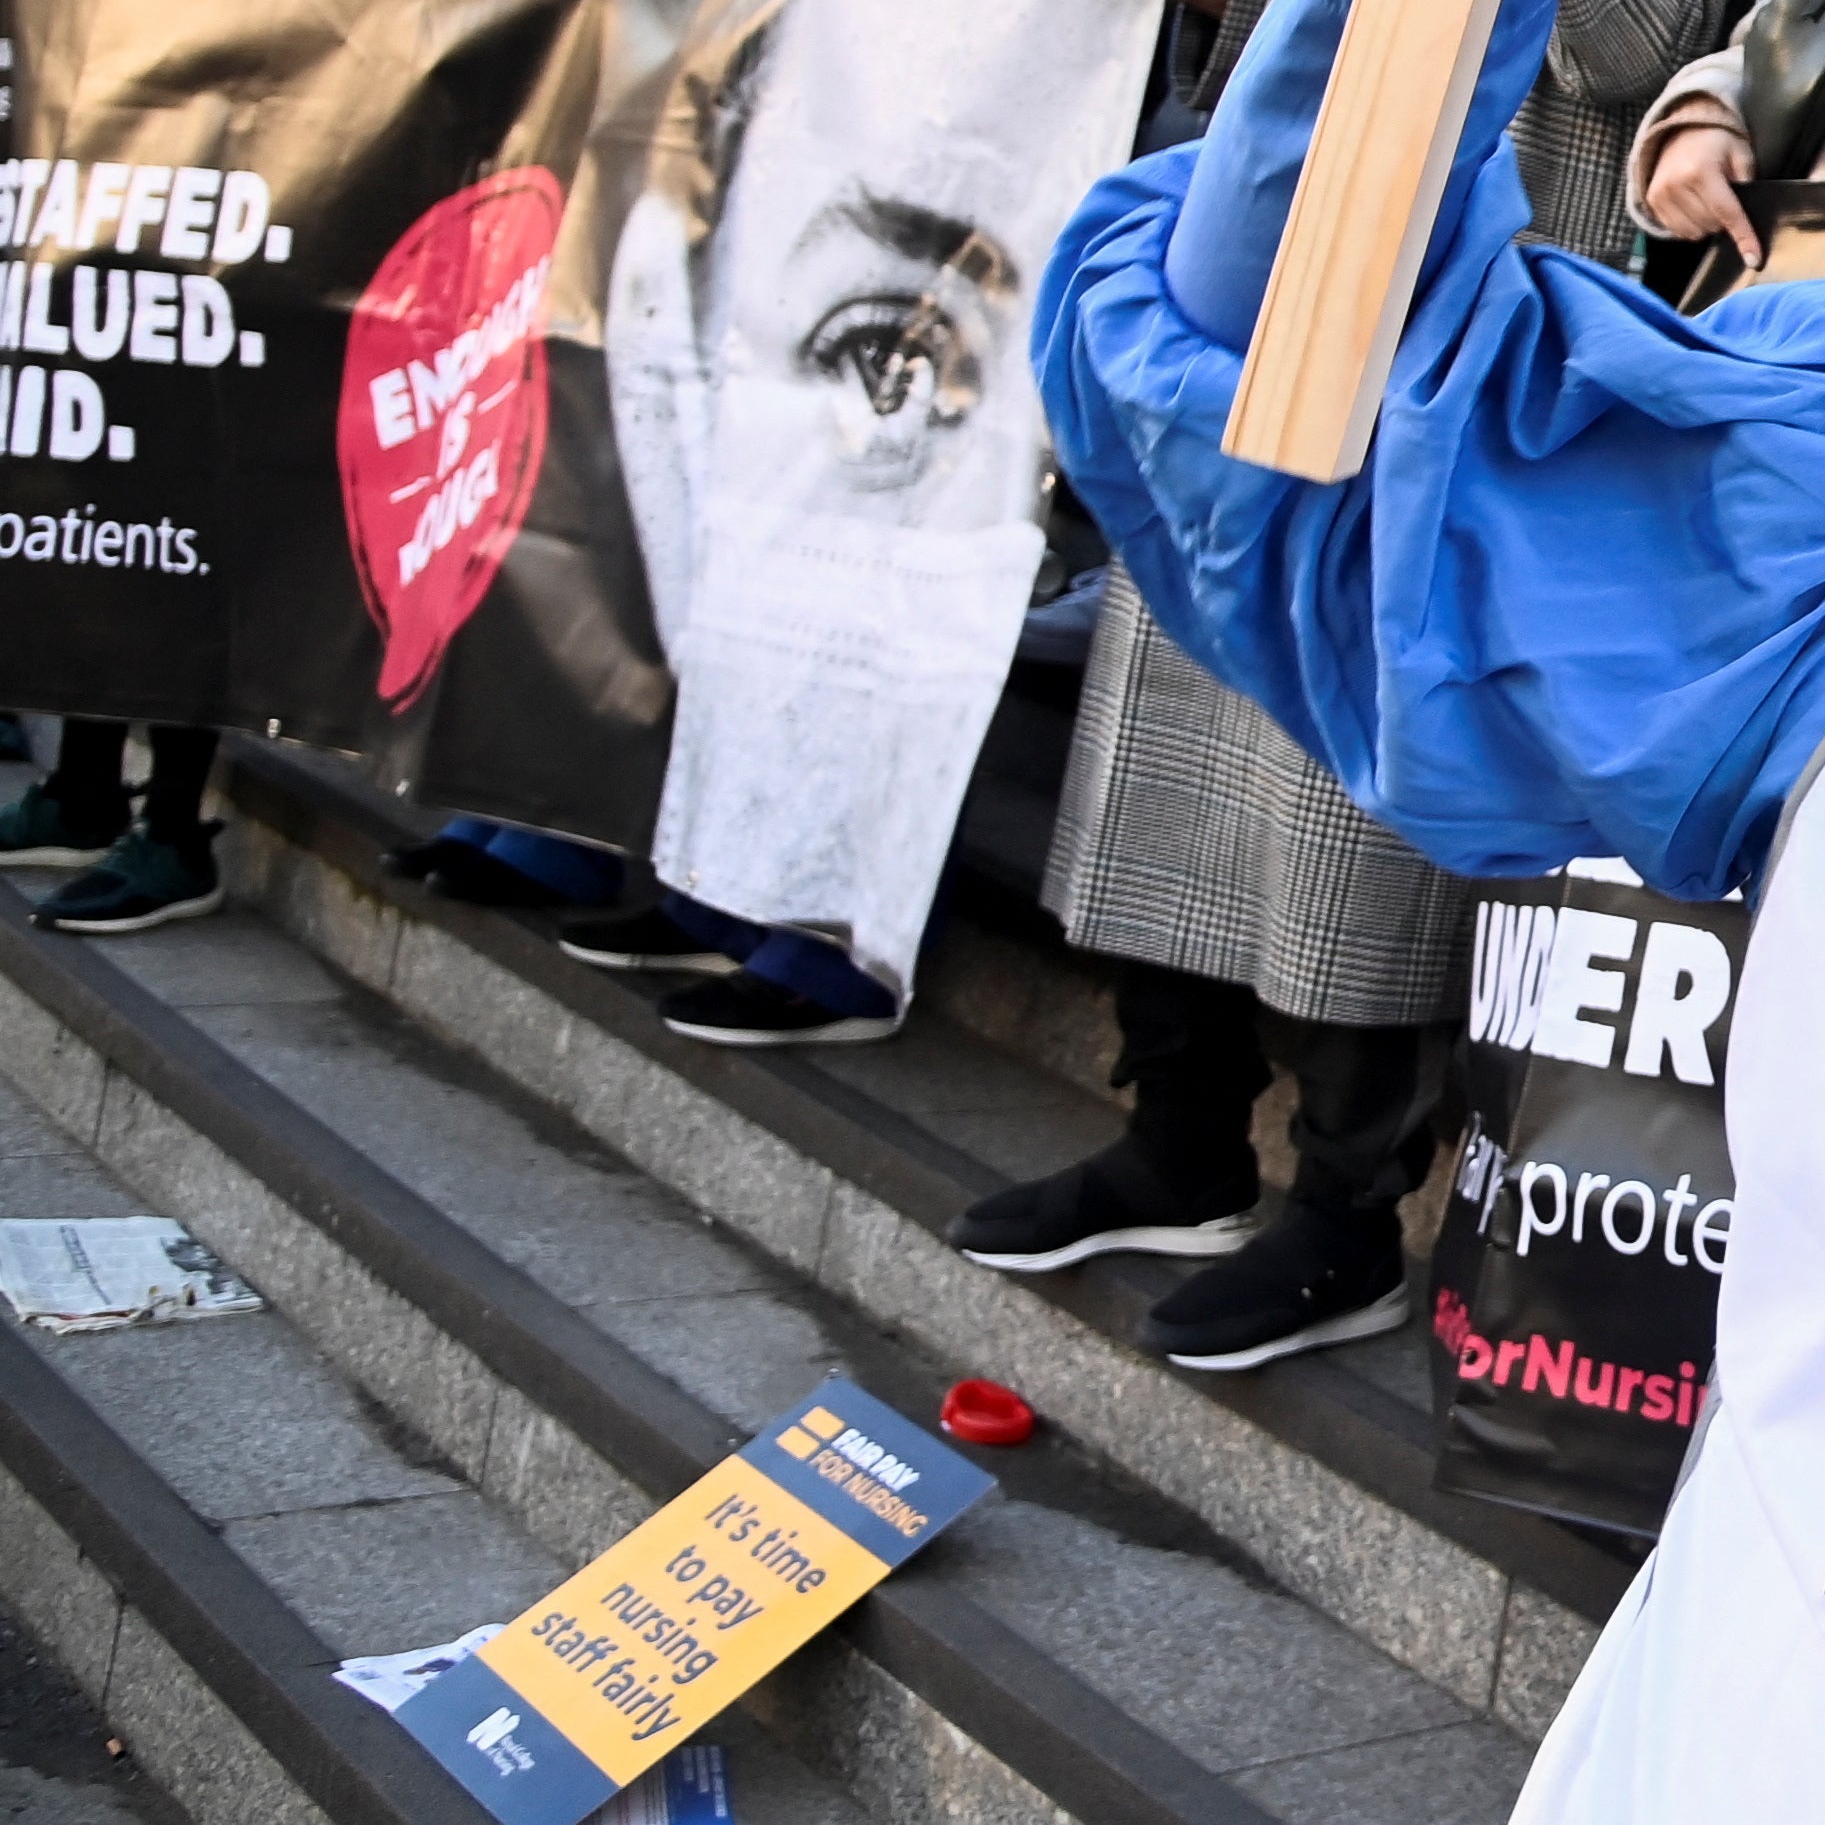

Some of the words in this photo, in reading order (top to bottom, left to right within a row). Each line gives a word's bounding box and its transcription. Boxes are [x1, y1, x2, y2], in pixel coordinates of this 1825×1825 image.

[1468, 900, 1732, 1087] UNDER
[808, 1449, 855, 1486] FOR
[841, 1472, 928, 1538] NURSING
[831, 1428, 885, 1470] FAIR
[868, 1453, 920, 1492] PAY
[664, 1545, 707, 1583] to
[686, 1574, 765, 1631] pay
[704, 1494, 761, 1542] It's
[750, 1529, 827, 1595] time
[531, 1610, 620, 1674] staff
[593, 1658, 681, 1742] fairly
[600, 1582, 719, 1685] nursing
